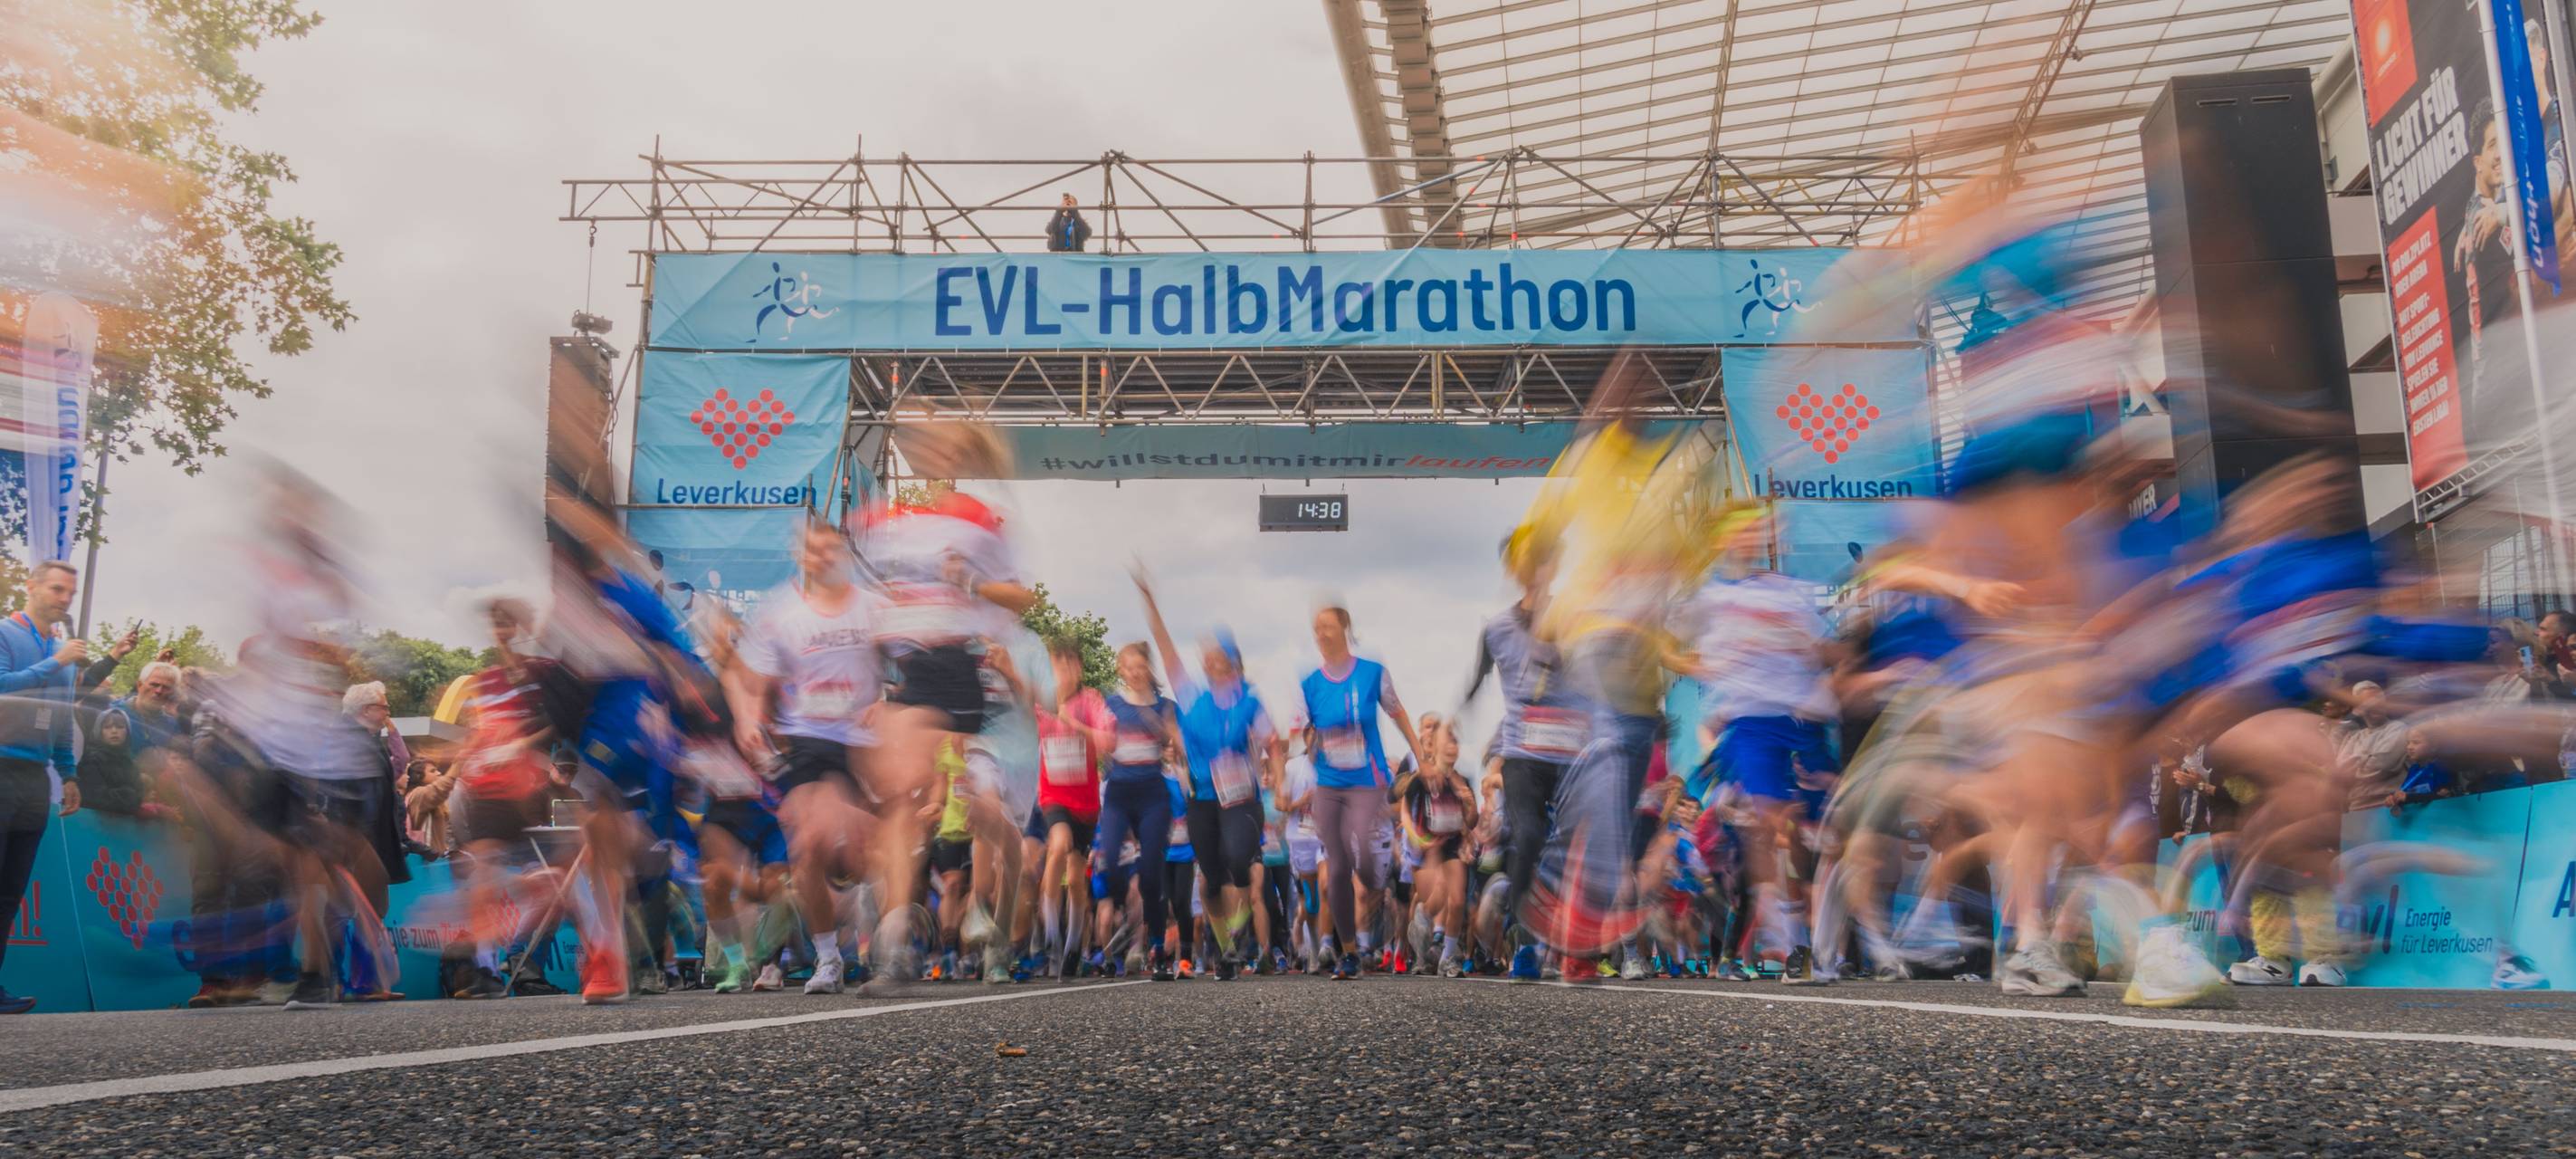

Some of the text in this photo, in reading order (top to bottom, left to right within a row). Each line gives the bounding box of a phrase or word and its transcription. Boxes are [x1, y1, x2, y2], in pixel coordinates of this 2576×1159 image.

[2376, 99, 2423, 181] LICHT
[2421, 66, 2460, 136] FÜR
[2382, 111, 2469, 225] GEWINNER
[934, 263, 1636, 336] EVL-HalbMarathon
[656, 478, 817, 506] Leverkusen
[1753, 474, 1913, 499] Leverkusen
[1296, 502, 1342, 520] 14:38
[2404, 906, 2452, 931] Energie
[411, 927, 441, 950] zum
[2400, 933, 2493, 953] für Leverkusen
